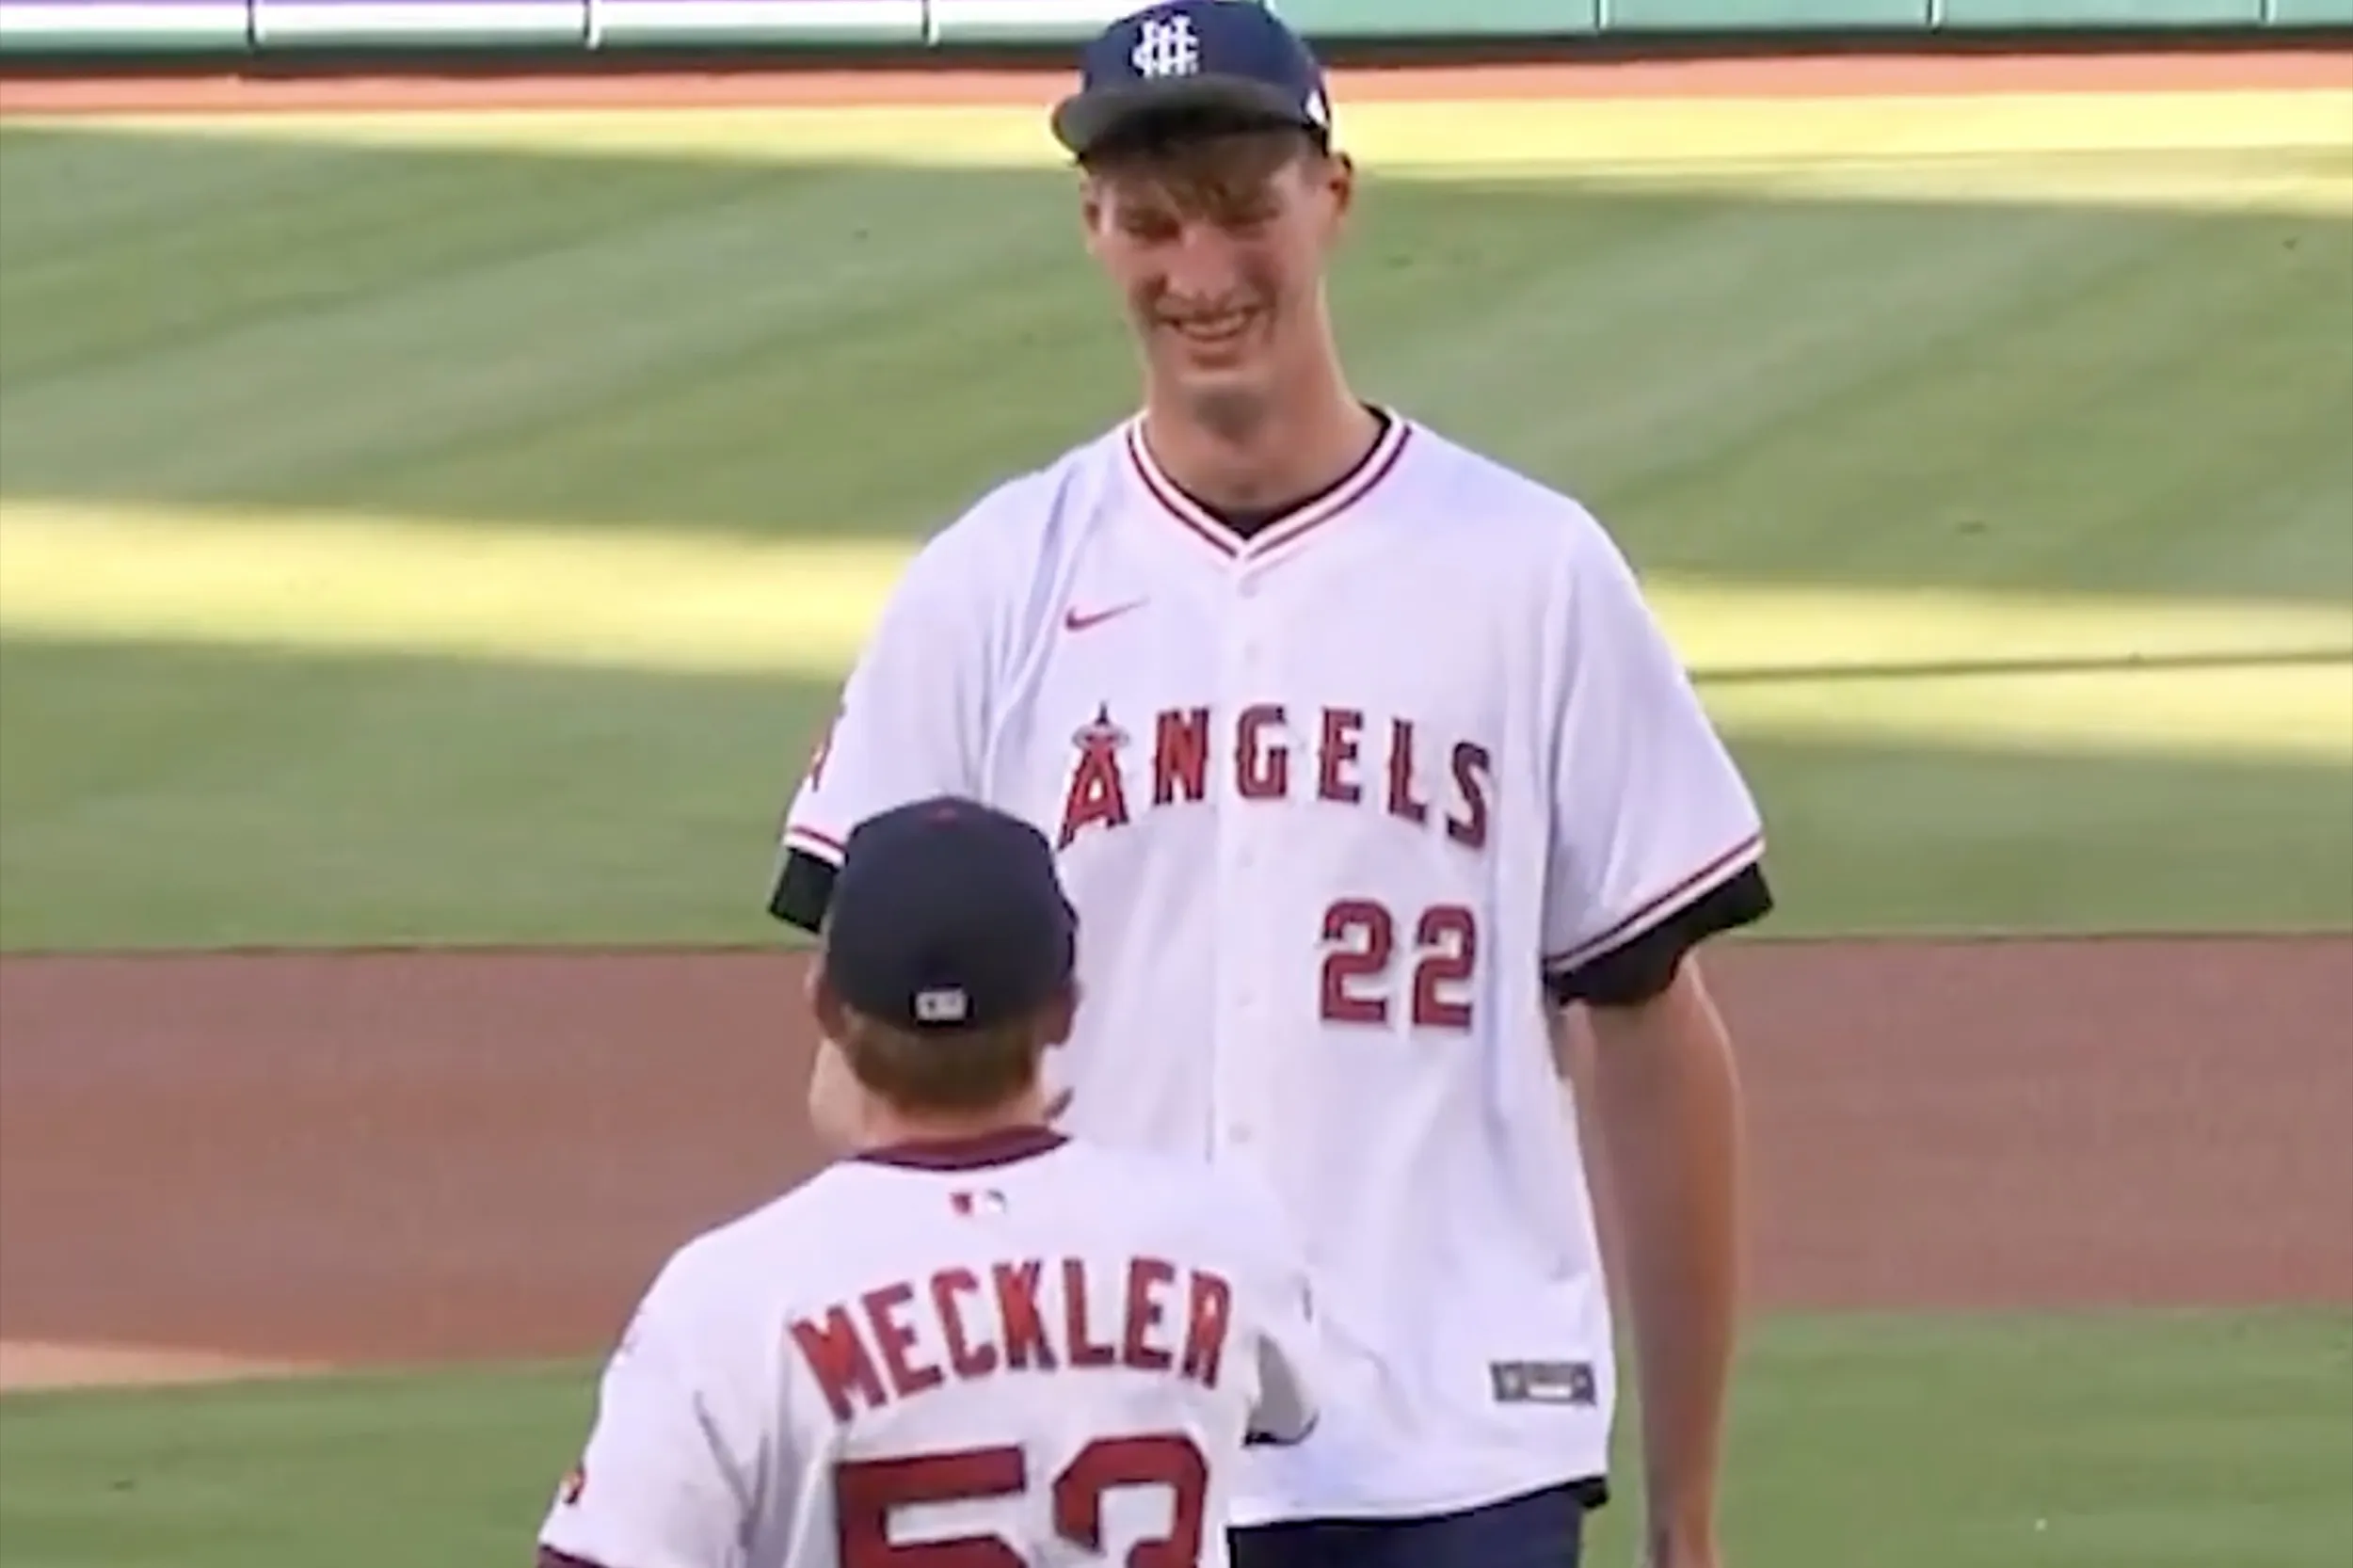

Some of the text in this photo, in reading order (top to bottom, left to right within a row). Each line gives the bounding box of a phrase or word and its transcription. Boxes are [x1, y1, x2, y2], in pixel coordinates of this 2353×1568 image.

[1057, 701, 1491, 849] ANGELS
[1321, 899, 1477, 1029] 22
[789, 1255, 1232, 1422] MECKLER
